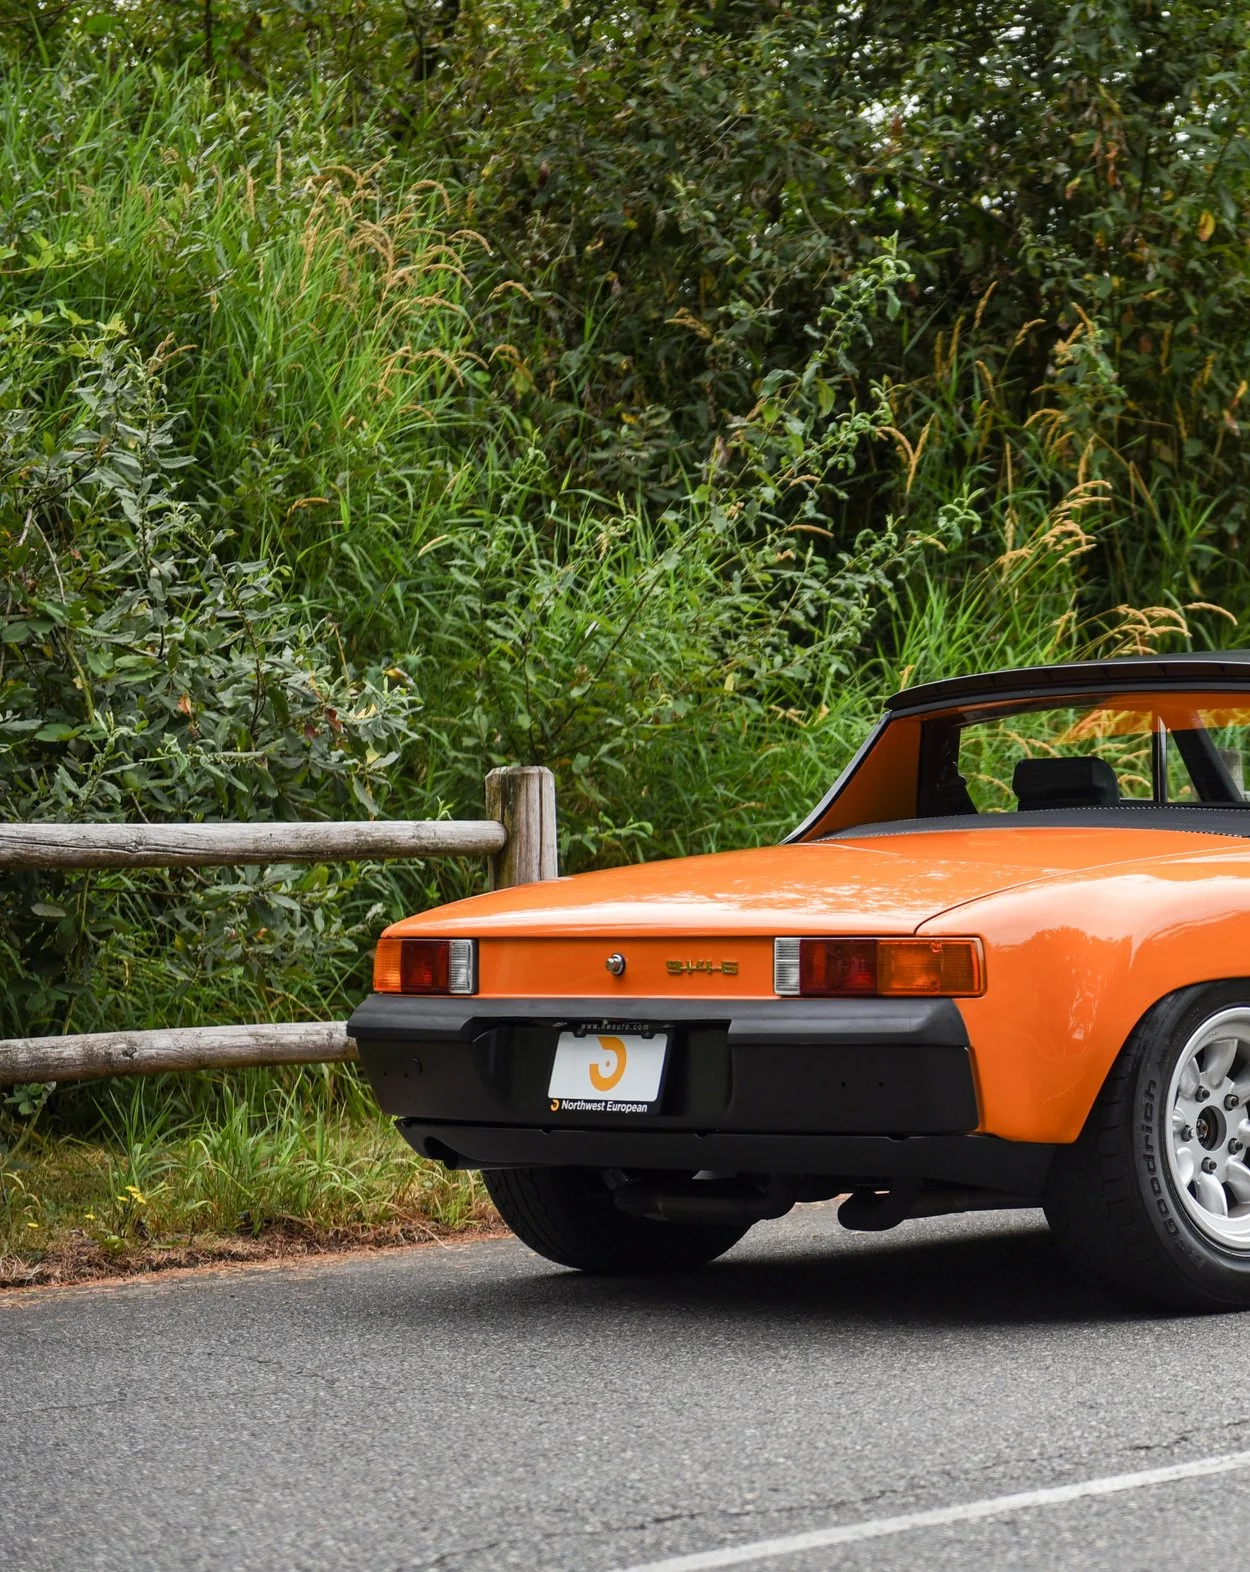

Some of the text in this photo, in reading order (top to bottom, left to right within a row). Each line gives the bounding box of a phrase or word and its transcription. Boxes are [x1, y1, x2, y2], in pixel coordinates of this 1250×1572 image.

[580, 1022, 649, 1031] www.nweuro.com
[561, 1100, 648, 1114] Northwest European
